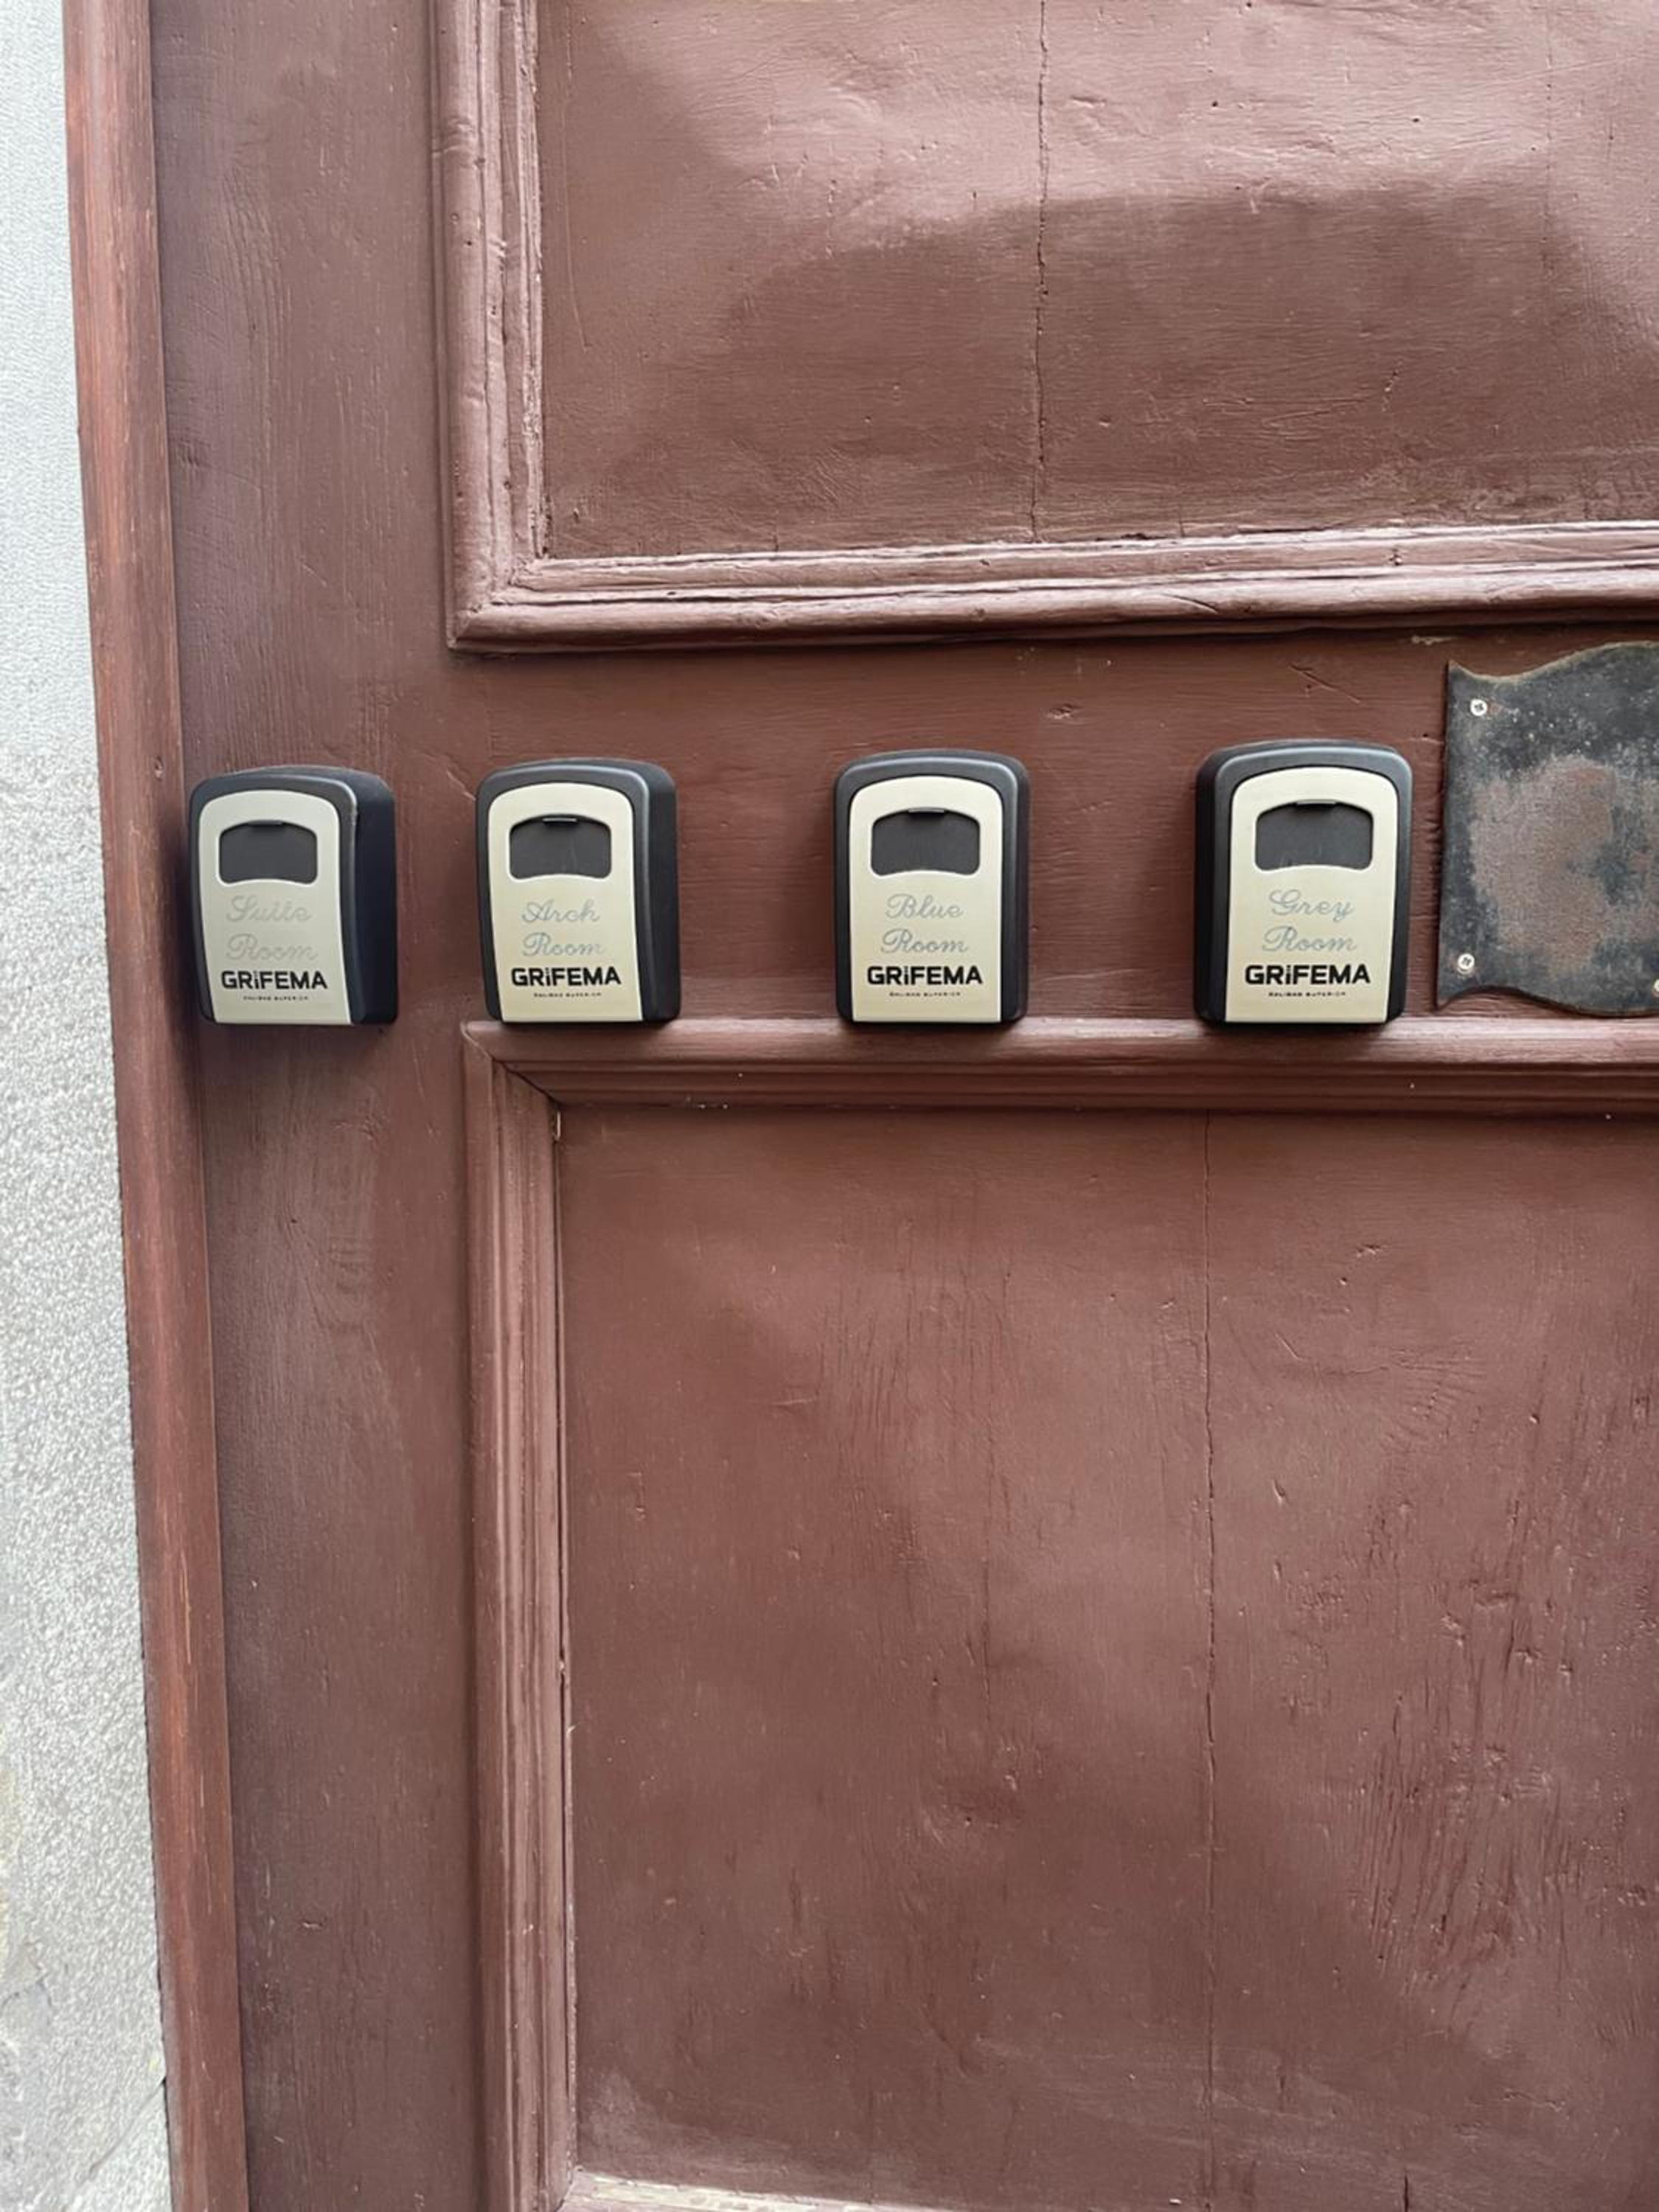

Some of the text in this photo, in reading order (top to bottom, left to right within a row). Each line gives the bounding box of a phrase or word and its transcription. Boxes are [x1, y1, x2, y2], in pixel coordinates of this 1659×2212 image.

[226, 894, 313, 922] Suite
[521, 898, 600, 922] Arch
[885, 893, 964, 919] Blue
[1268, 888, 1354, 922] Grey
[226, 933, 319, 960] Room
[522, 932, 605, 956] Room
[880, 928, 969, 954] Room
[1262, 925, 1357, 952] Room
